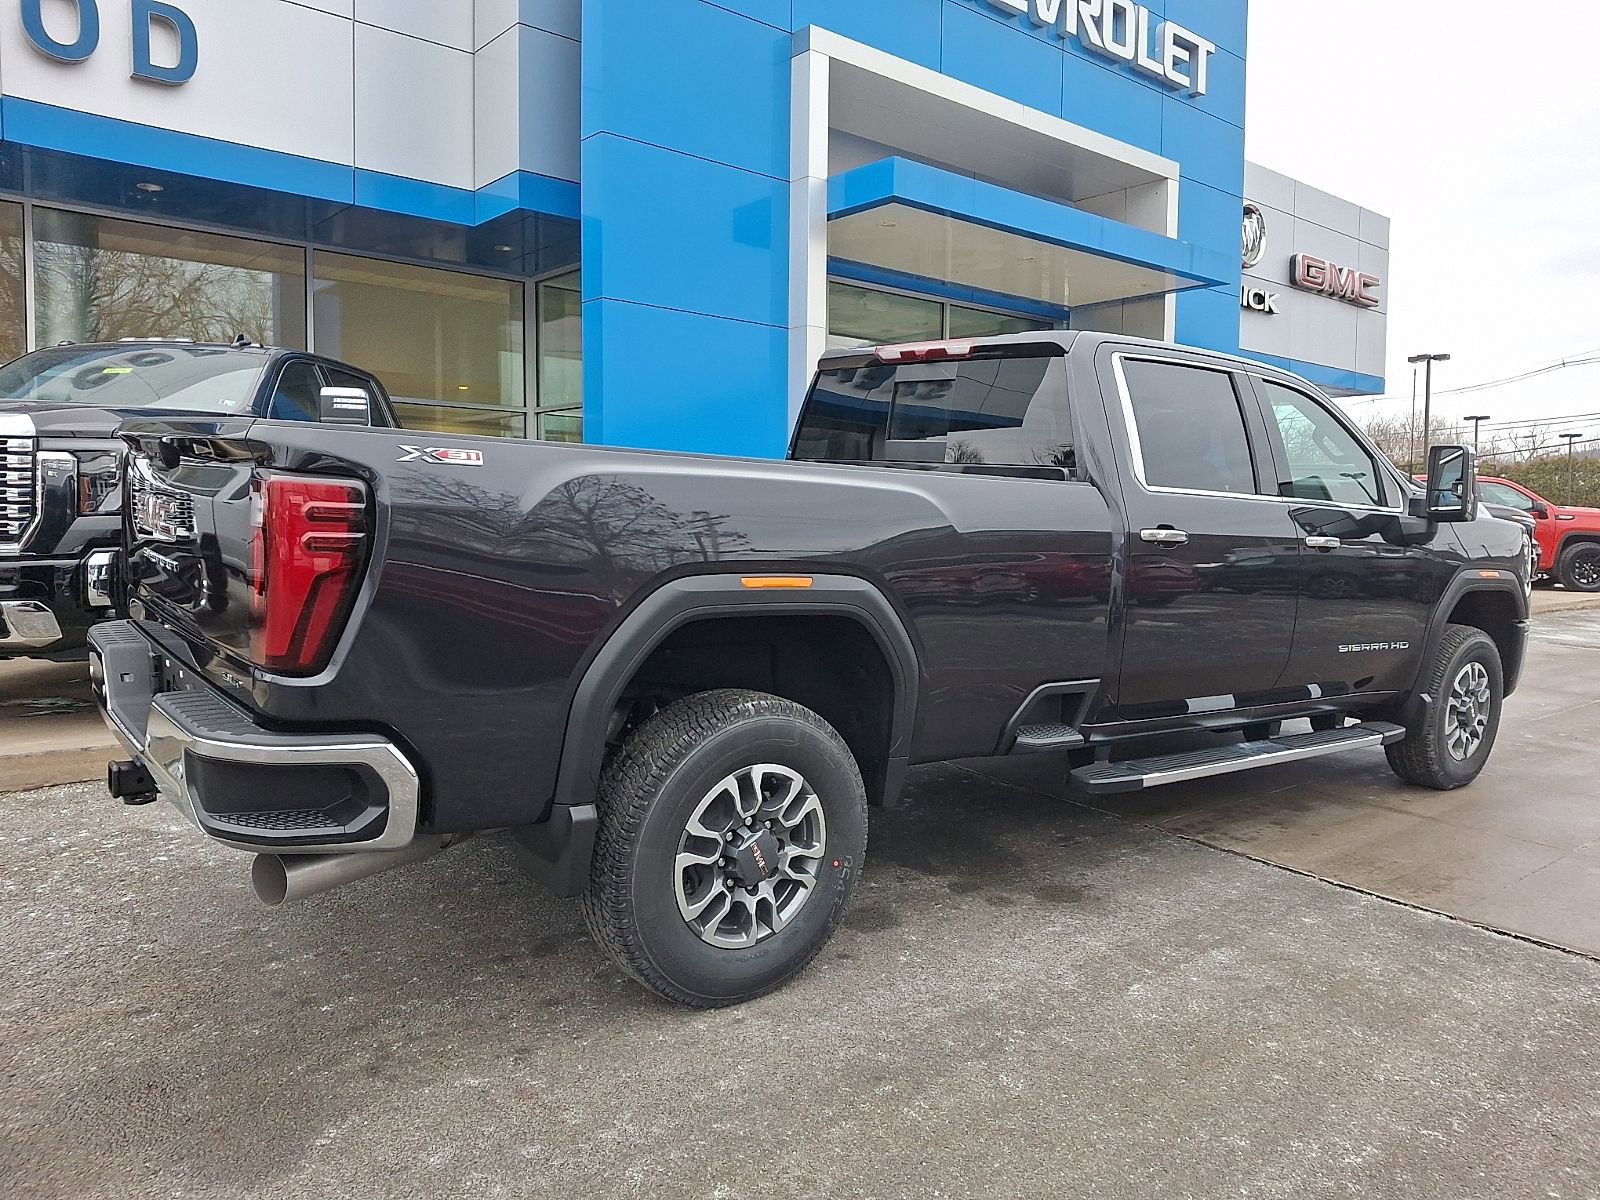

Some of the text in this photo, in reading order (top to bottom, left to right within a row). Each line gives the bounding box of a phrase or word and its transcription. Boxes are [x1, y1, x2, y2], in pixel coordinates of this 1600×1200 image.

[982, 0, 1216, 97] ROLET
[1290, 252, 1380, 307] GMC
[396, 444, 484, 467] X31
[1338, 641, 1410, 653] SIERRA HD
[749, 841, 769, 876] GMC
